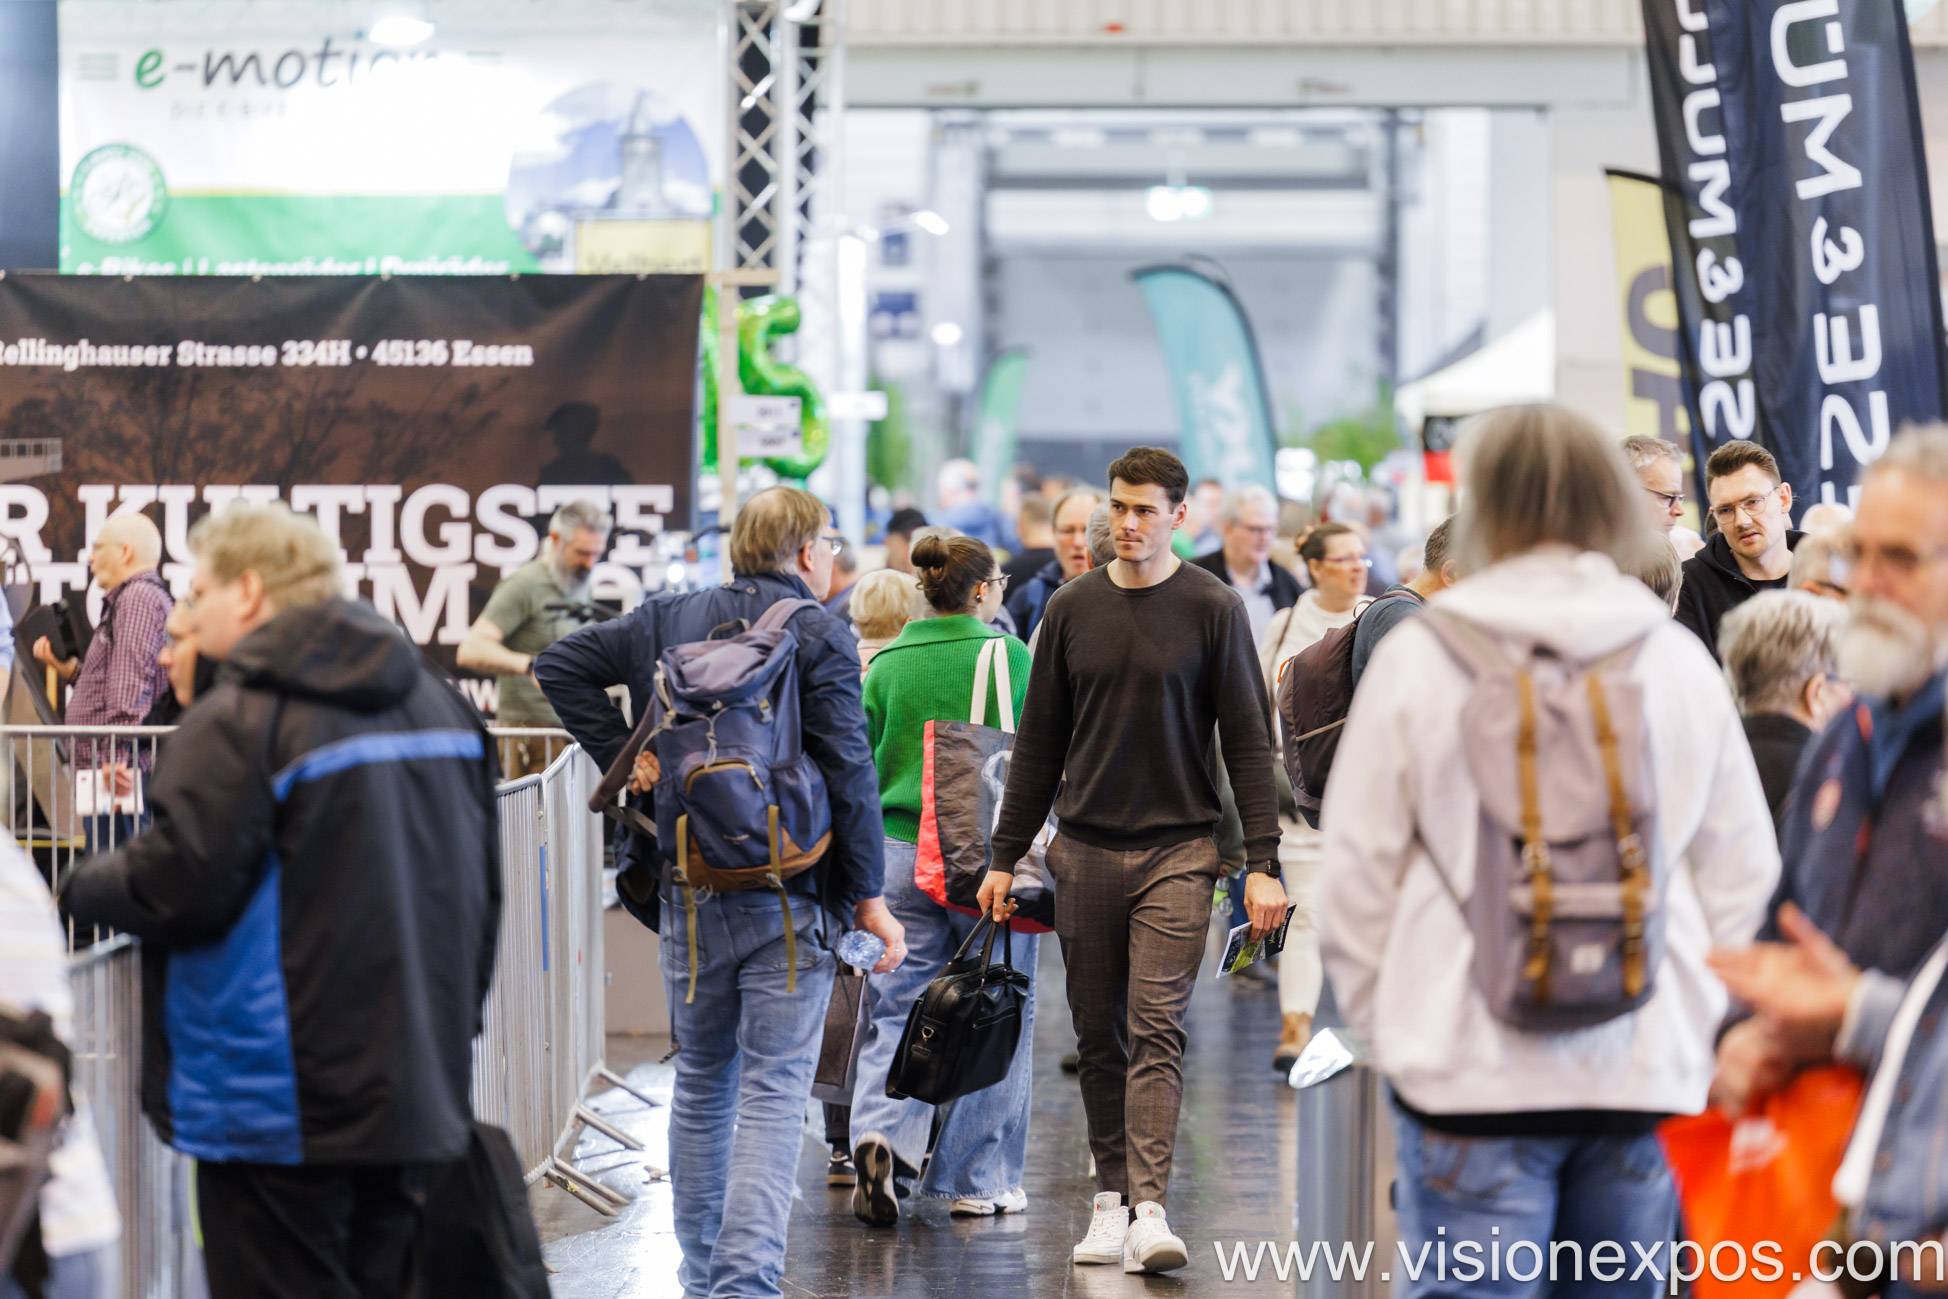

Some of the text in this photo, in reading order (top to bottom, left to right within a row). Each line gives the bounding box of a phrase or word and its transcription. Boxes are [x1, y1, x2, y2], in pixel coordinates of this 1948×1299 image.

[176, 340, 278, 367] Strasse
[371, 339, 450, 367] 45136
[451, 339, 534, 367] Essen
